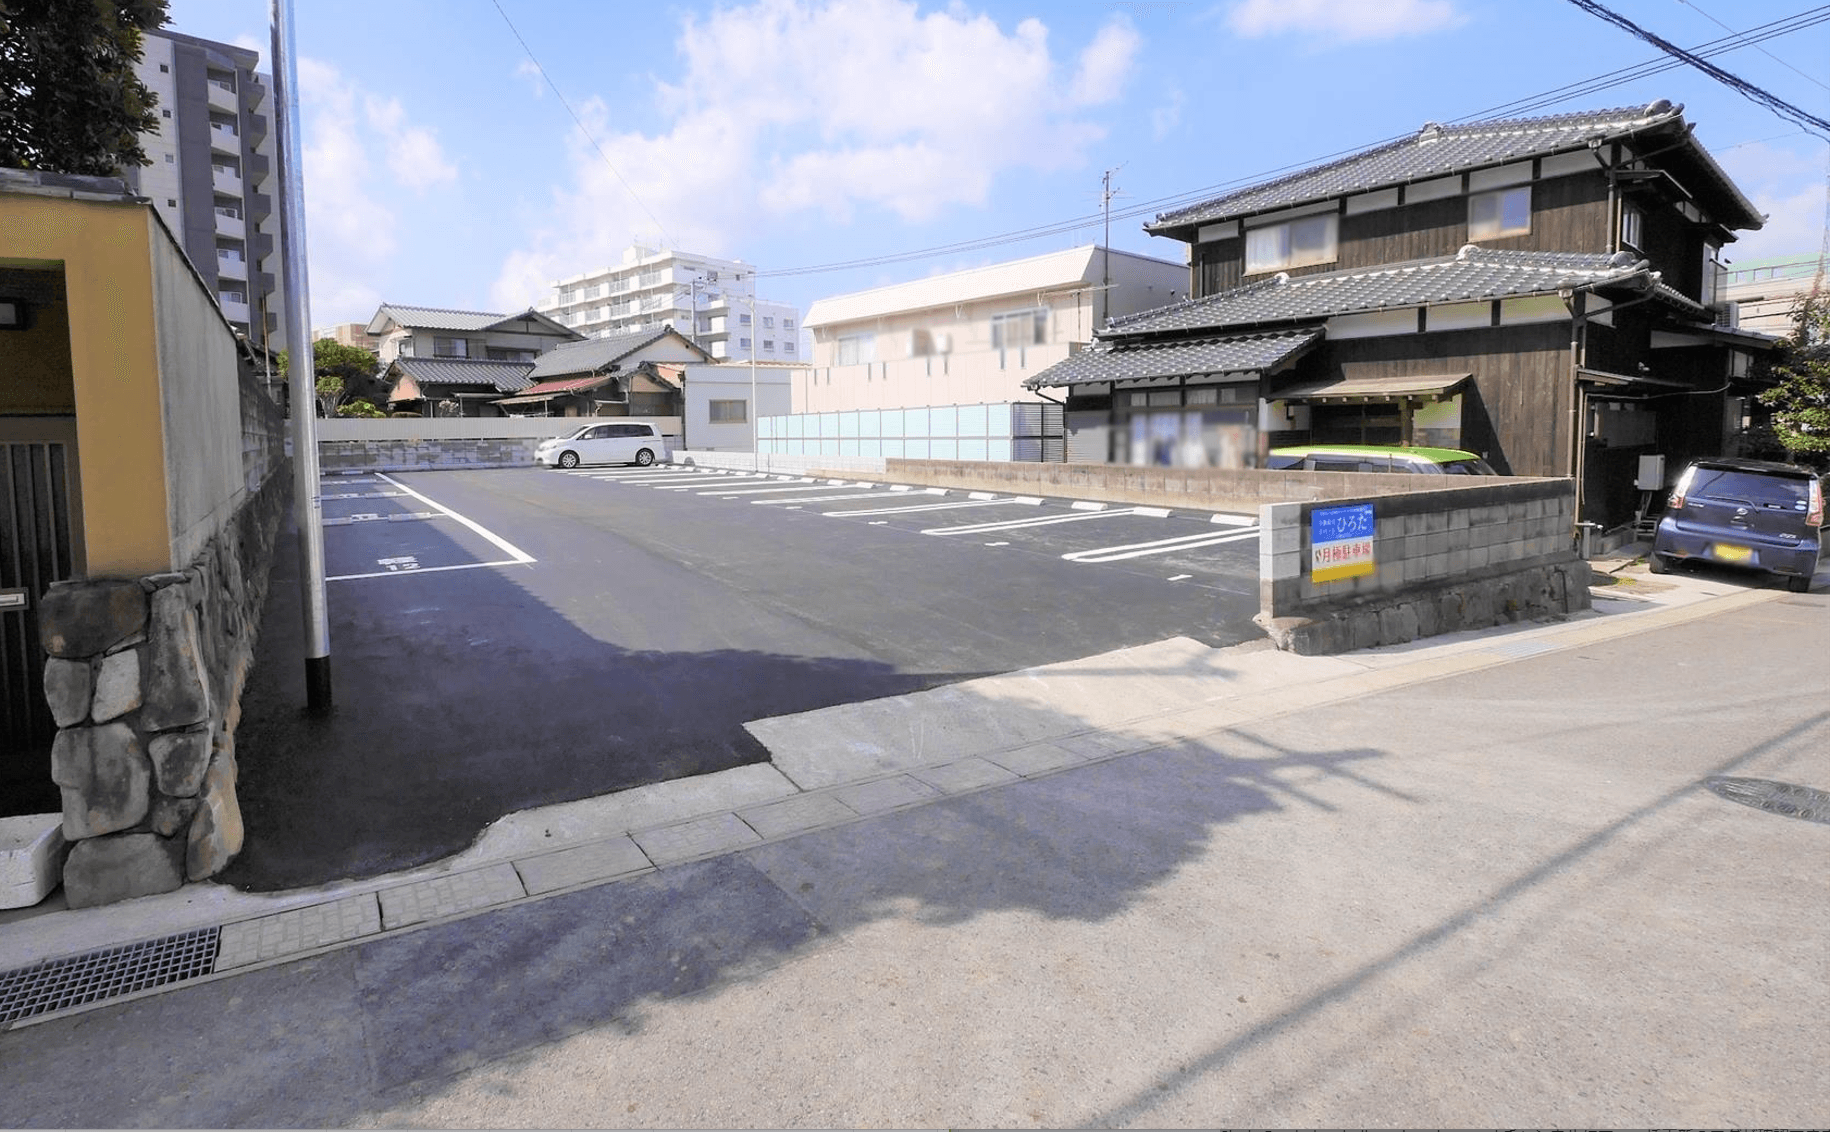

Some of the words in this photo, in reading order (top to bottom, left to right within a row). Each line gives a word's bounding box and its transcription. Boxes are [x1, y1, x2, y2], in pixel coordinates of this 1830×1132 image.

[1323, 542, 1372, 562] 月極駐車場
